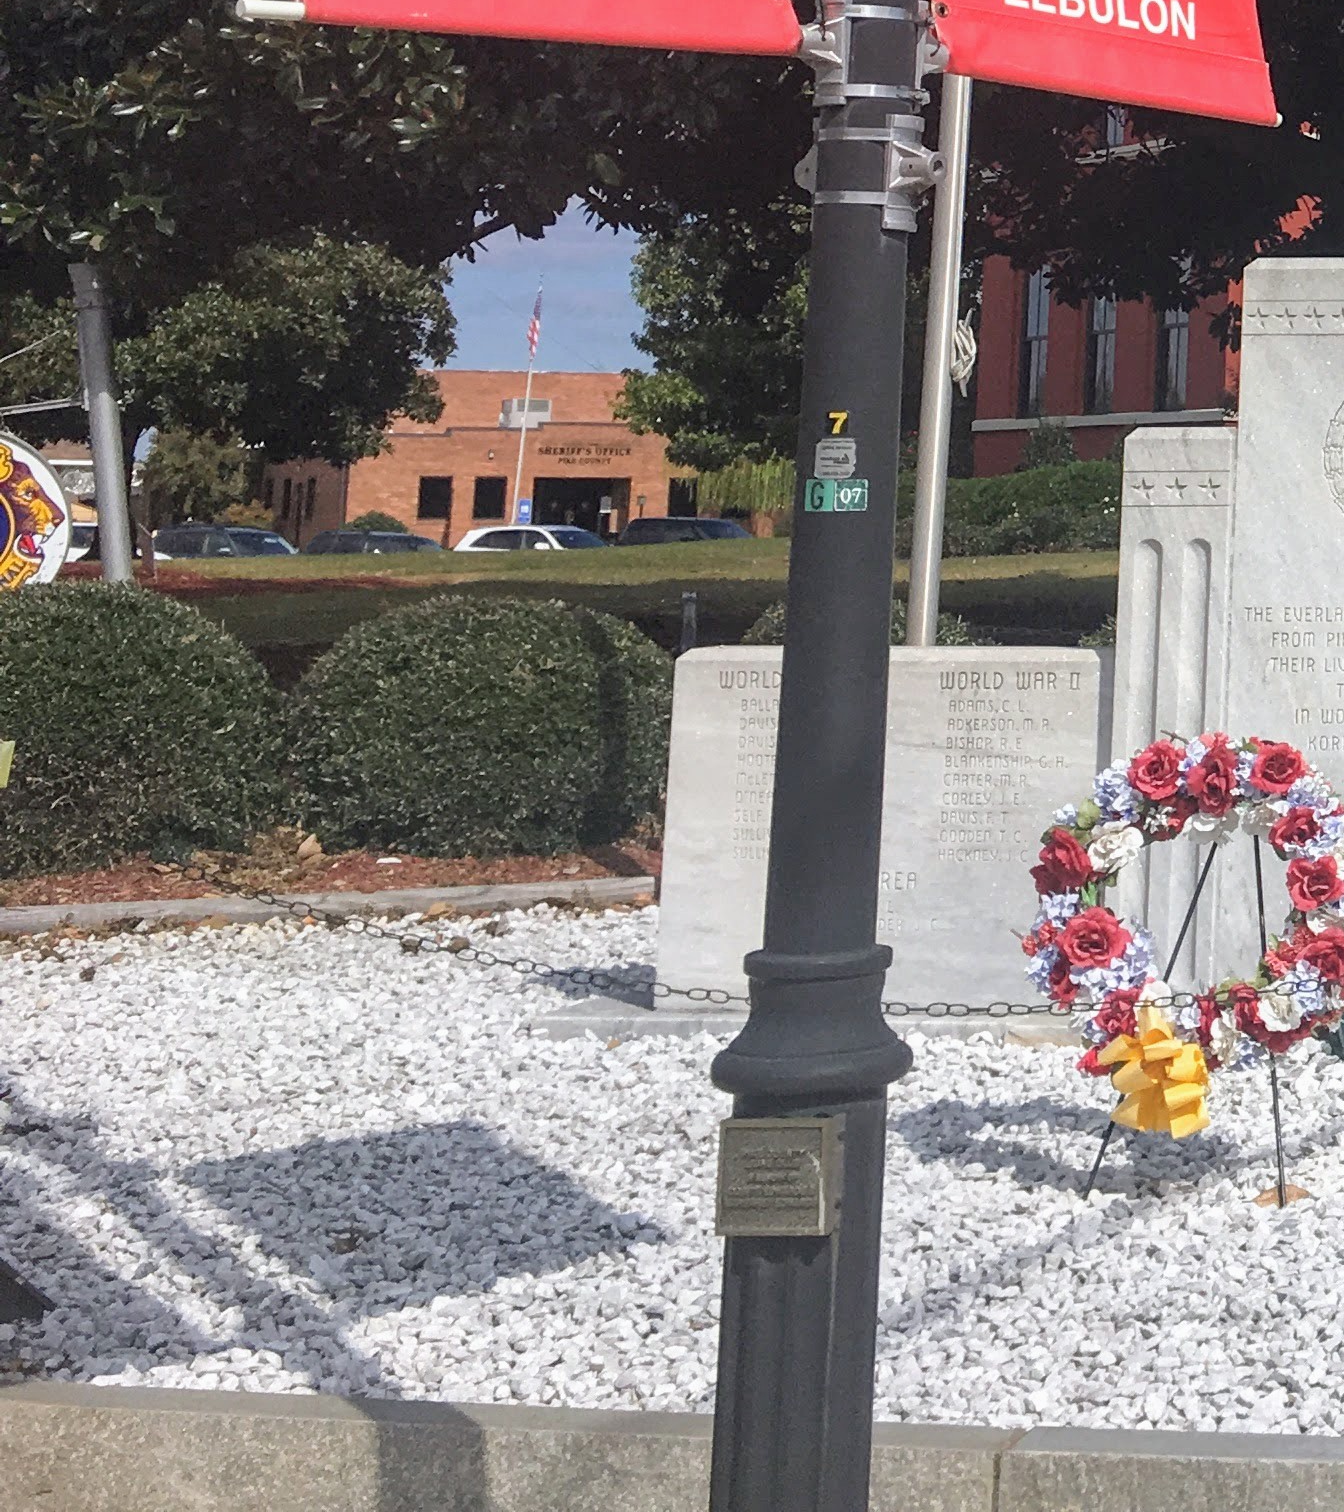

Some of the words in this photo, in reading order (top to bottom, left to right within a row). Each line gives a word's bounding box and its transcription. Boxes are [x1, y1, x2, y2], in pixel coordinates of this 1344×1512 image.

[829, 411, 848, 434] 7
[811, 482, 824, 510] G
[840, 488, 861, 504] 07
[1244, 606, 1273, 622] THE
[1271, 632, 1315, 648] FROM
[1271, 657, 1315, 672] THEIR
[719, 670, 782, 690] WORLD
[940, 671, 1004, 690] WORLD
[1016, 672, 1058, 690] WAR
[1069, 672, 1080, 690] II
[1295, 708, 1310, 724] IN
